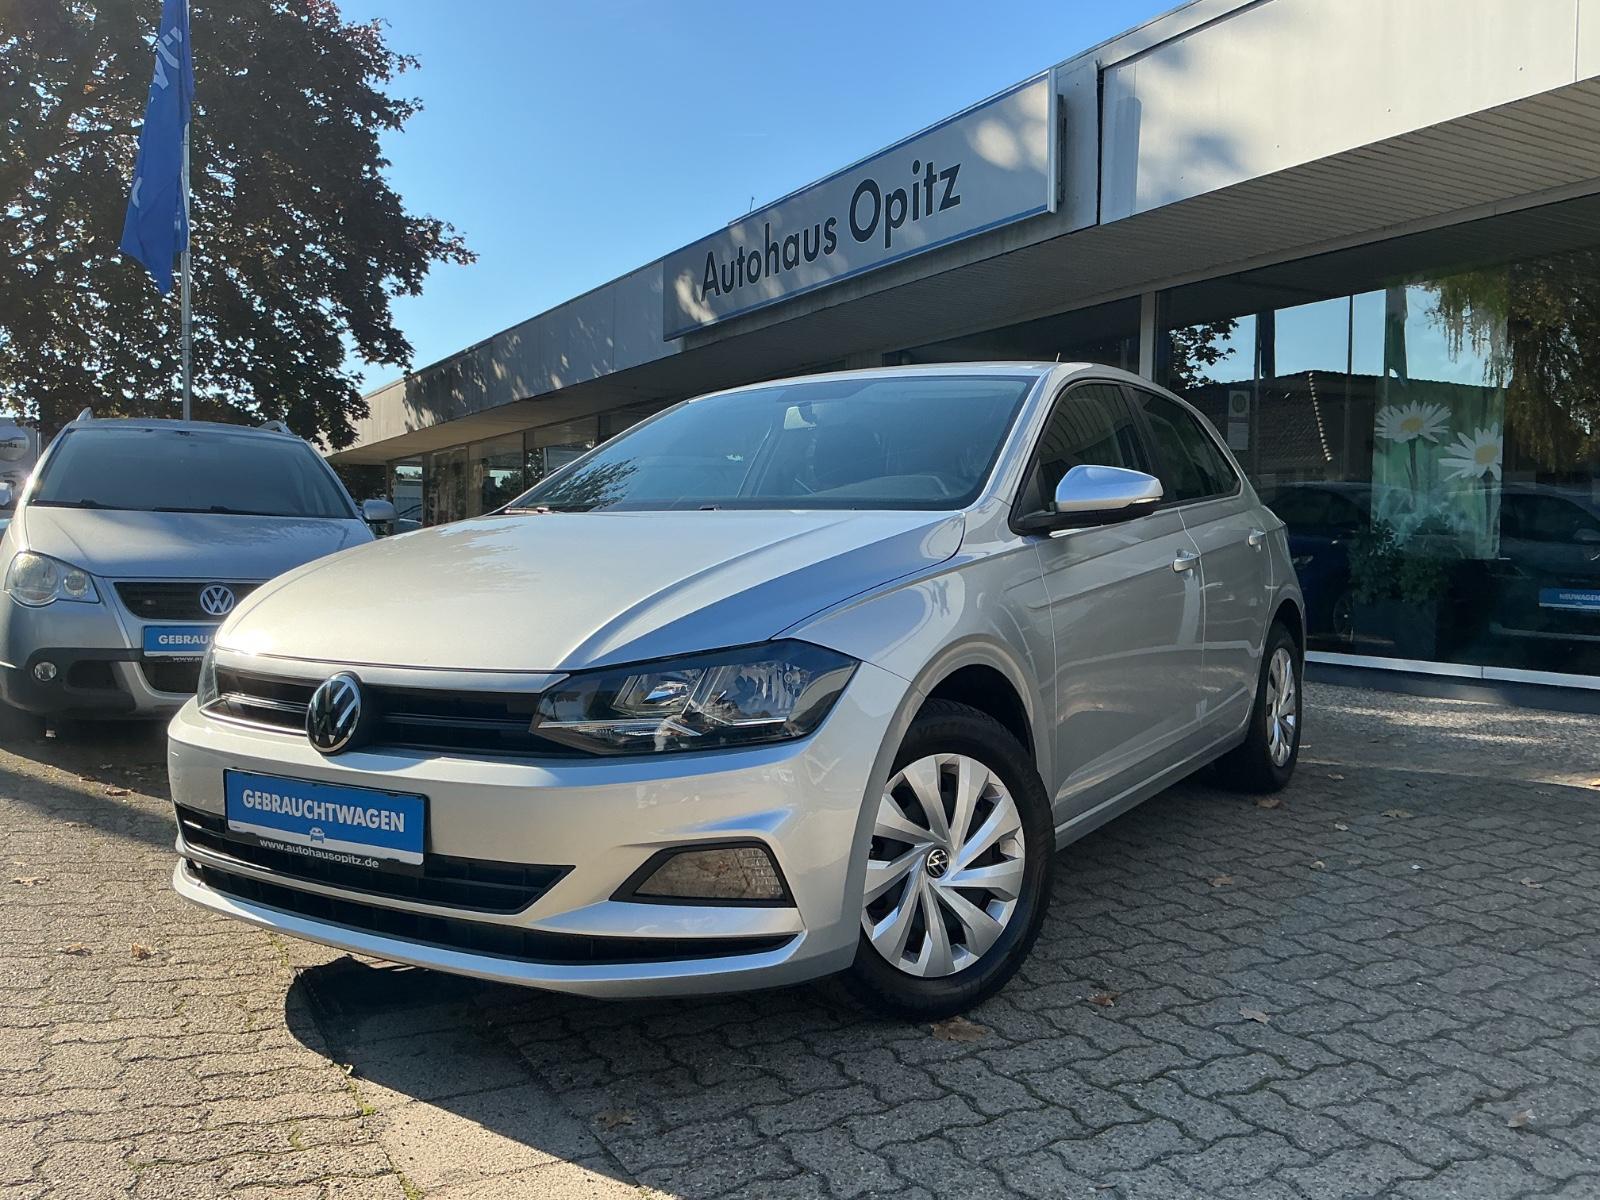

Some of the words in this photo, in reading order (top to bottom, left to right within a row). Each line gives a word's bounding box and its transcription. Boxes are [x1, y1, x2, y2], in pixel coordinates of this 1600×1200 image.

[701, 215, 838, 301] Autohaus
[849, 159, 961, 249] Opitz
[158, 634, 211, 645] GEBRAU
[242, 789, 405, 833] GEBRAUCHTWAGEN
[259, 839, 380, 868] www.autohausopitz.de
